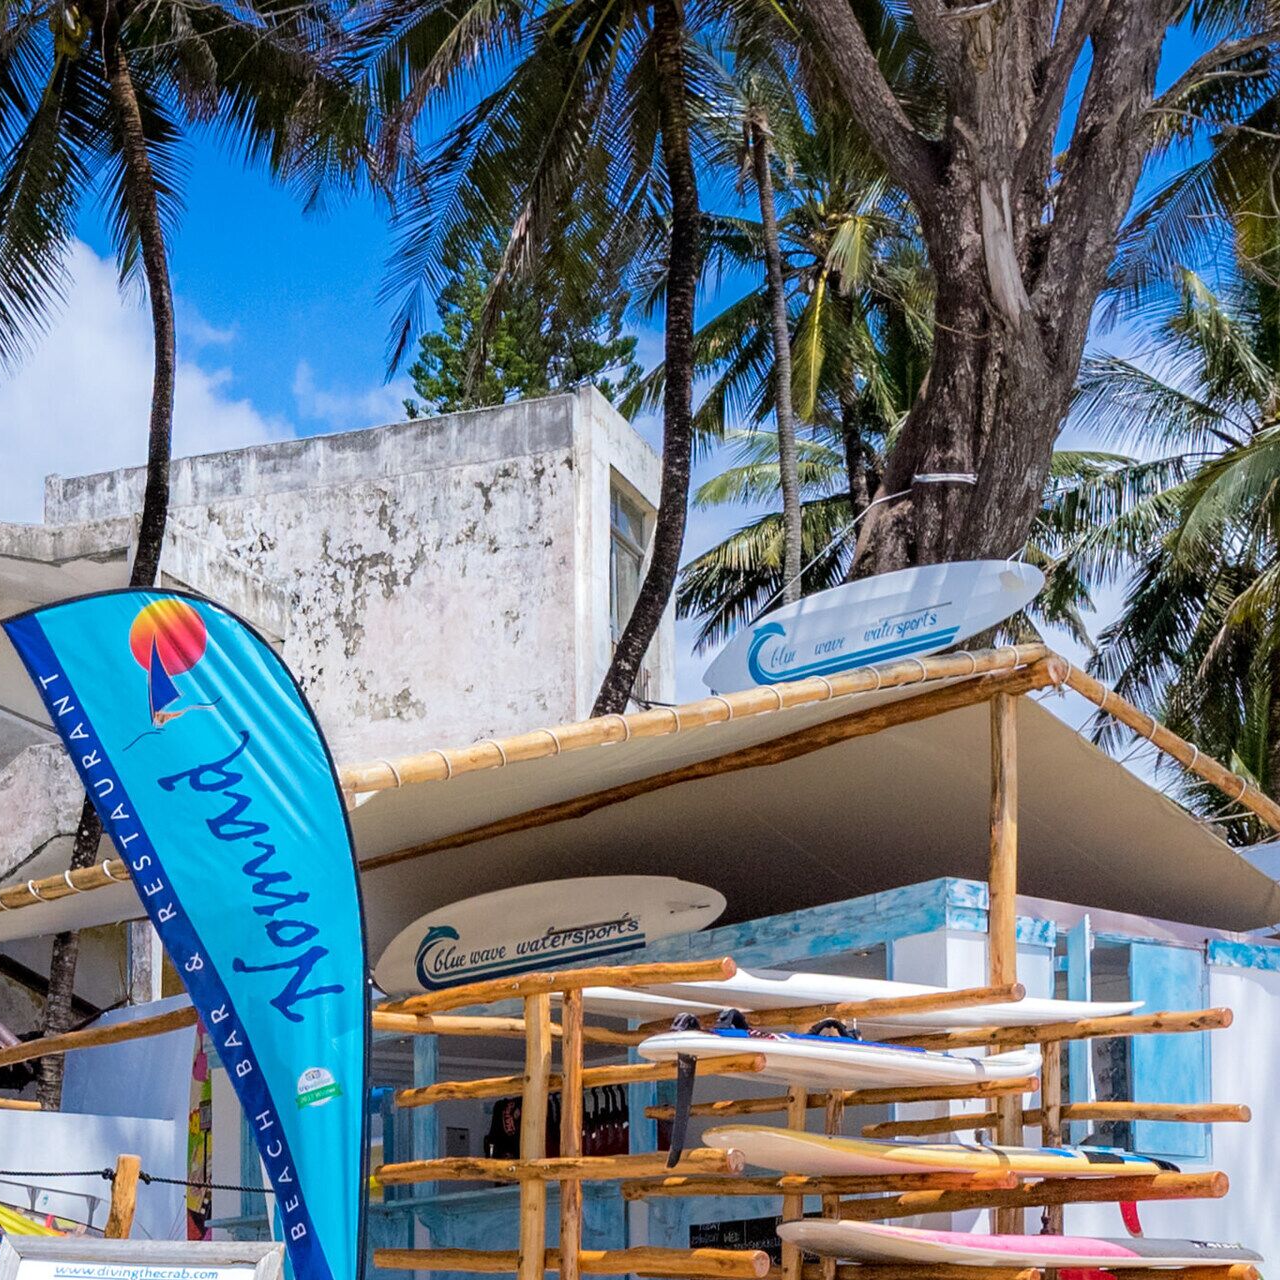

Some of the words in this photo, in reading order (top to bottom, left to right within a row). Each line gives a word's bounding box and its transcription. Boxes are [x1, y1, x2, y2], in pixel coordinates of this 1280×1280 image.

[815, 636, 846, 655] wave
[863, 611, 938, 642] watersports
[39, 672, 179, 923] RESTAURANT
[157, 729, 345, 1023] Nomad
[184, 955, 205, 973] &
[434, 946, 467, 973] blue
[470, 946, 507, 964] wave
[516, 912, 639, 955] watersports
[211, 1004, 254, 1078] BAR
[256, 1112, 308, 1241] BEACH
